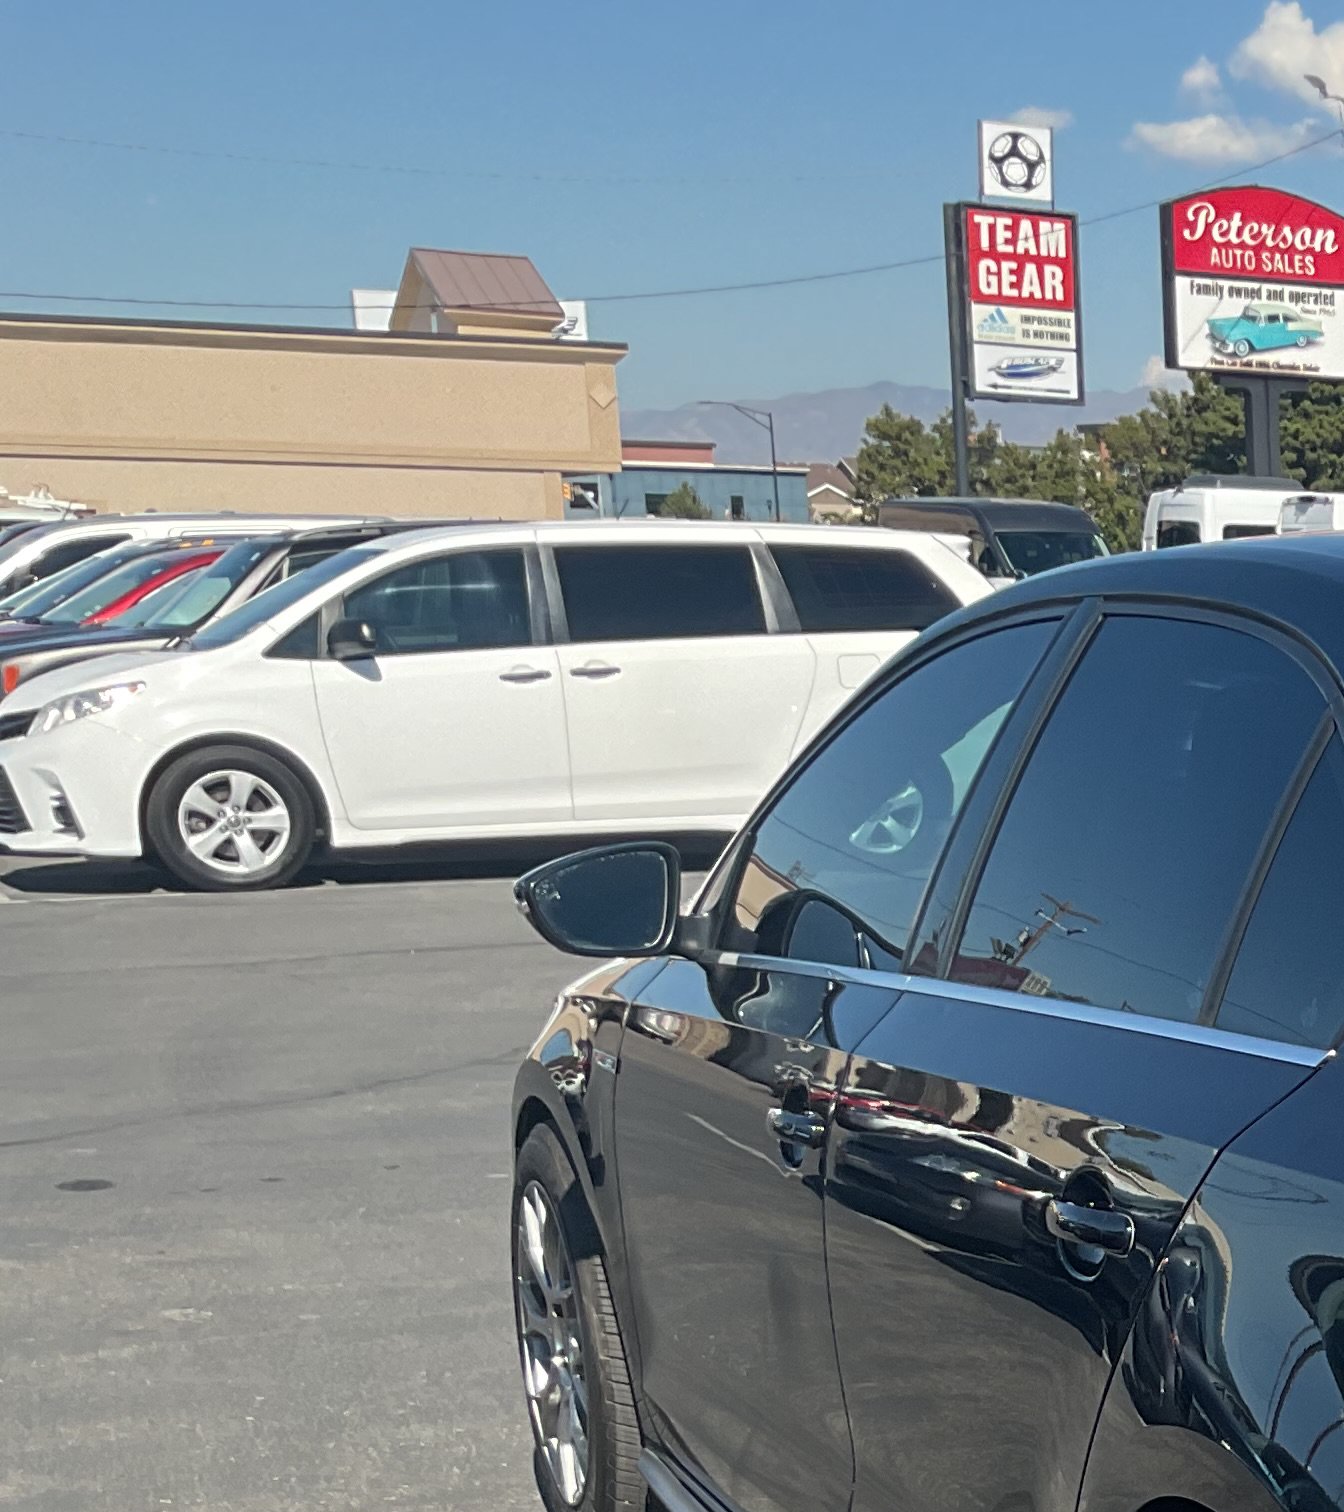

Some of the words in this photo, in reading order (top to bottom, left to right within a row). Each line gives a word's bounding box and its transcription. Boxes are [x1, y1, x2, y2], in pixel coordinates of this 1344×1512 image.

[973, 214, 1066, 258] TEAM
[1183, 202, 1338, 254] Peterson
[1210, 247, 1256, 271] AUTO
[1262, 252, 1315, 276] SALES
[978, 258, 1065, 301] GEAR
[1190, 280, 1224, 300] Family
[1228, 285, 1262, 300] owned
[1266, 287, 1285, 302] and
[1289, 290, 1335, 307] operated
[1020, 314, 1072, 329] IMPOSSIBLE
[1022, 328, 1031, 339] IS
[1033, 330, 1071, 342] NOTHING
